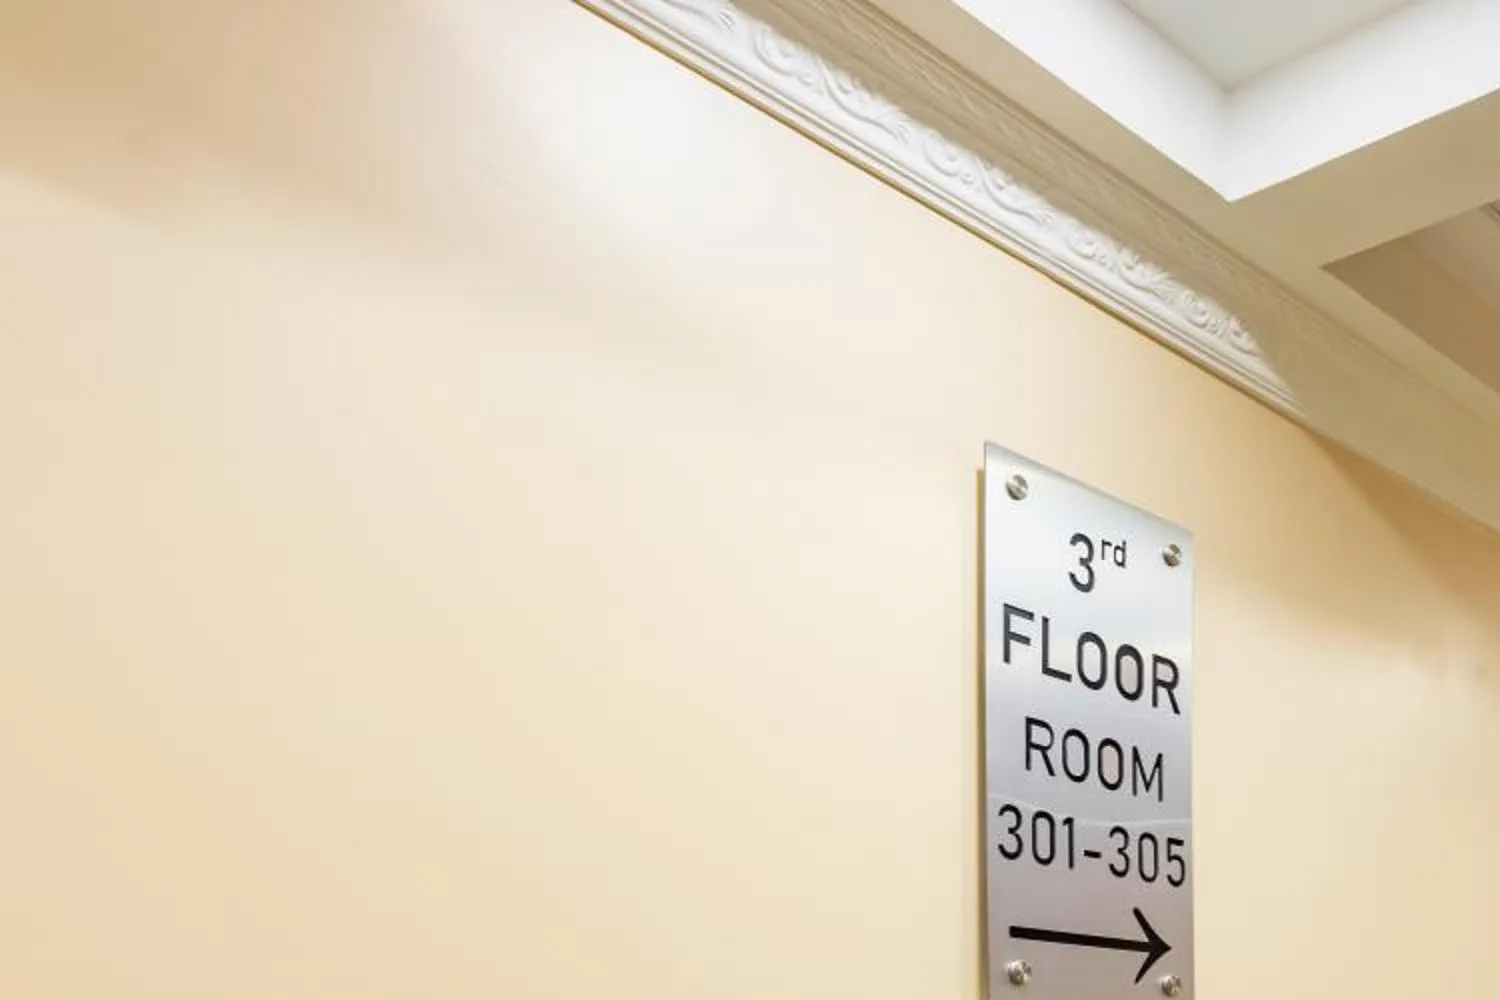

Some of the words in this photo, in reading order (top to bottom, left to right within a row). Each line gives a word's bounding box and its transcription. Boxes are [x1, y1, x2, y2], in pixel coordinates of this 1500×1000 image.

[1068, 532, 1127, 593] 3rd
[1002, 603, 1181, 715] FLOOR
[1025, 716, 1164, 803] ROOM
[997, 803, 1186, 888] 301-305
